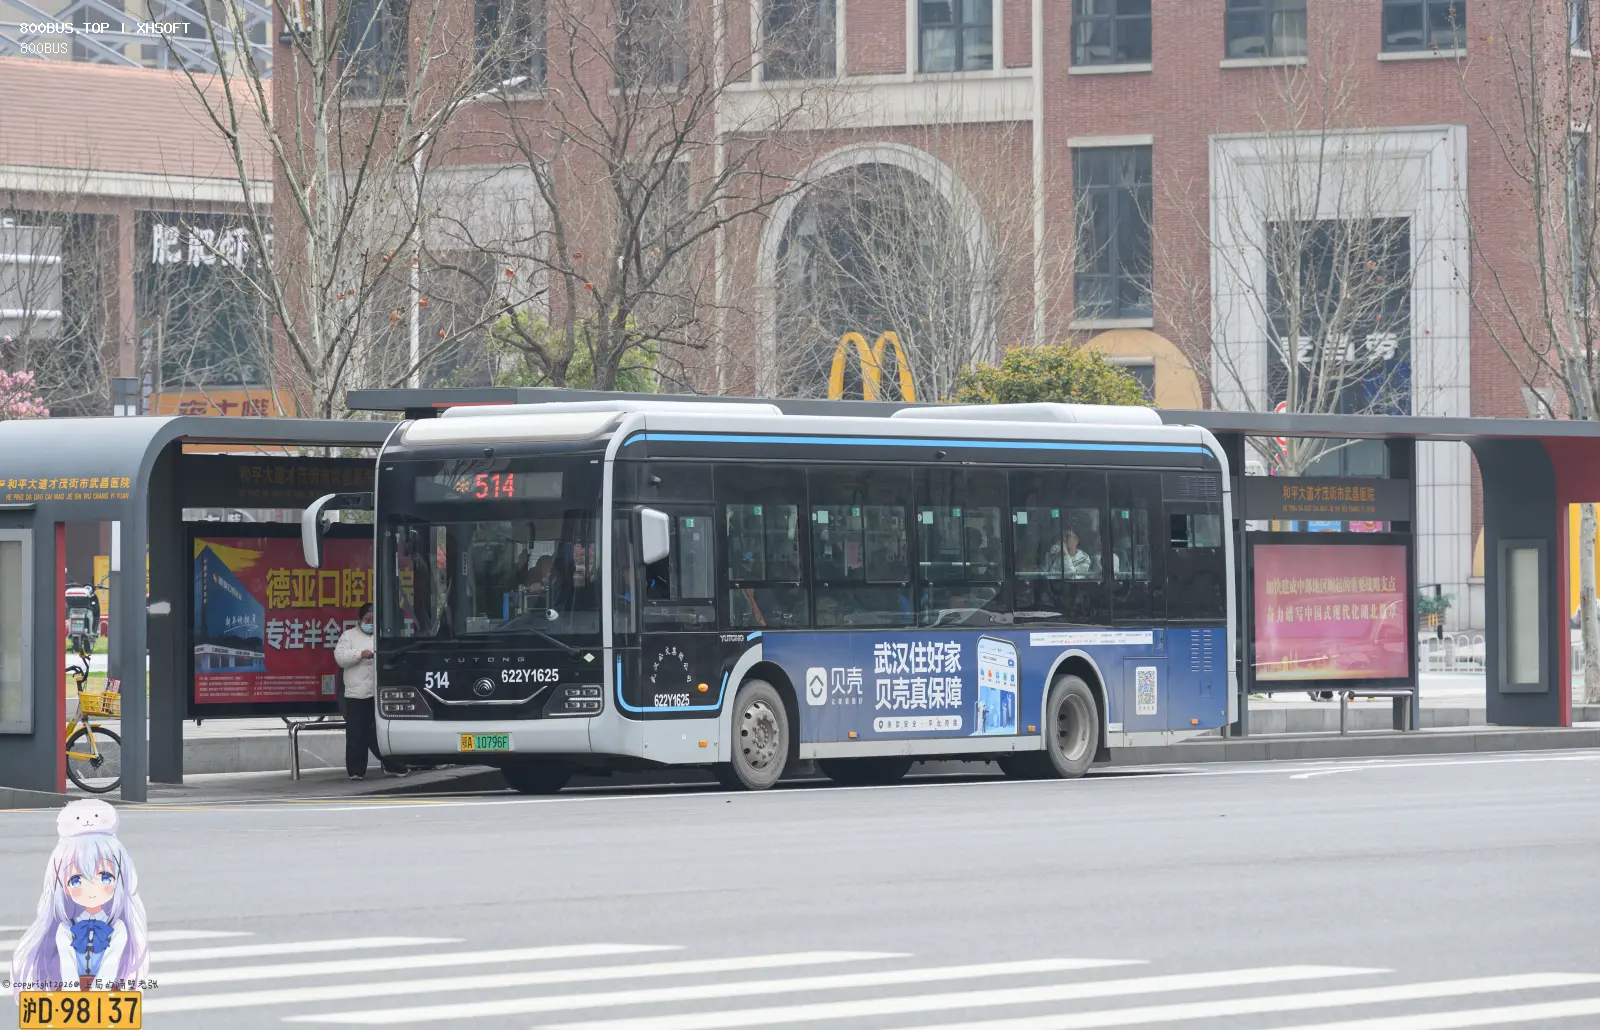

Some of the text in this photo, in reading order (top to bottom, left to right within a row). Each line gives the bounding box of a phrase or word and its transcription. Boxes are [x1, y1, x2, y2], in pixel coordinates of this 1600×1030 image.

[8, 476, 131, 490] 和平大道才茂街市武昌医院
[475, 473, 514, 499] 514
[873, 641, 962, 674] 武汉住好家
[425, 671, 450, 689] 514
[501, 668, 560, 683] 622Y1625
[831, 667, 863, 695] 贝壳
[654, 693, 690, 707] 622Y1625
[874, 676, 963, 710] 贝壳真保障
